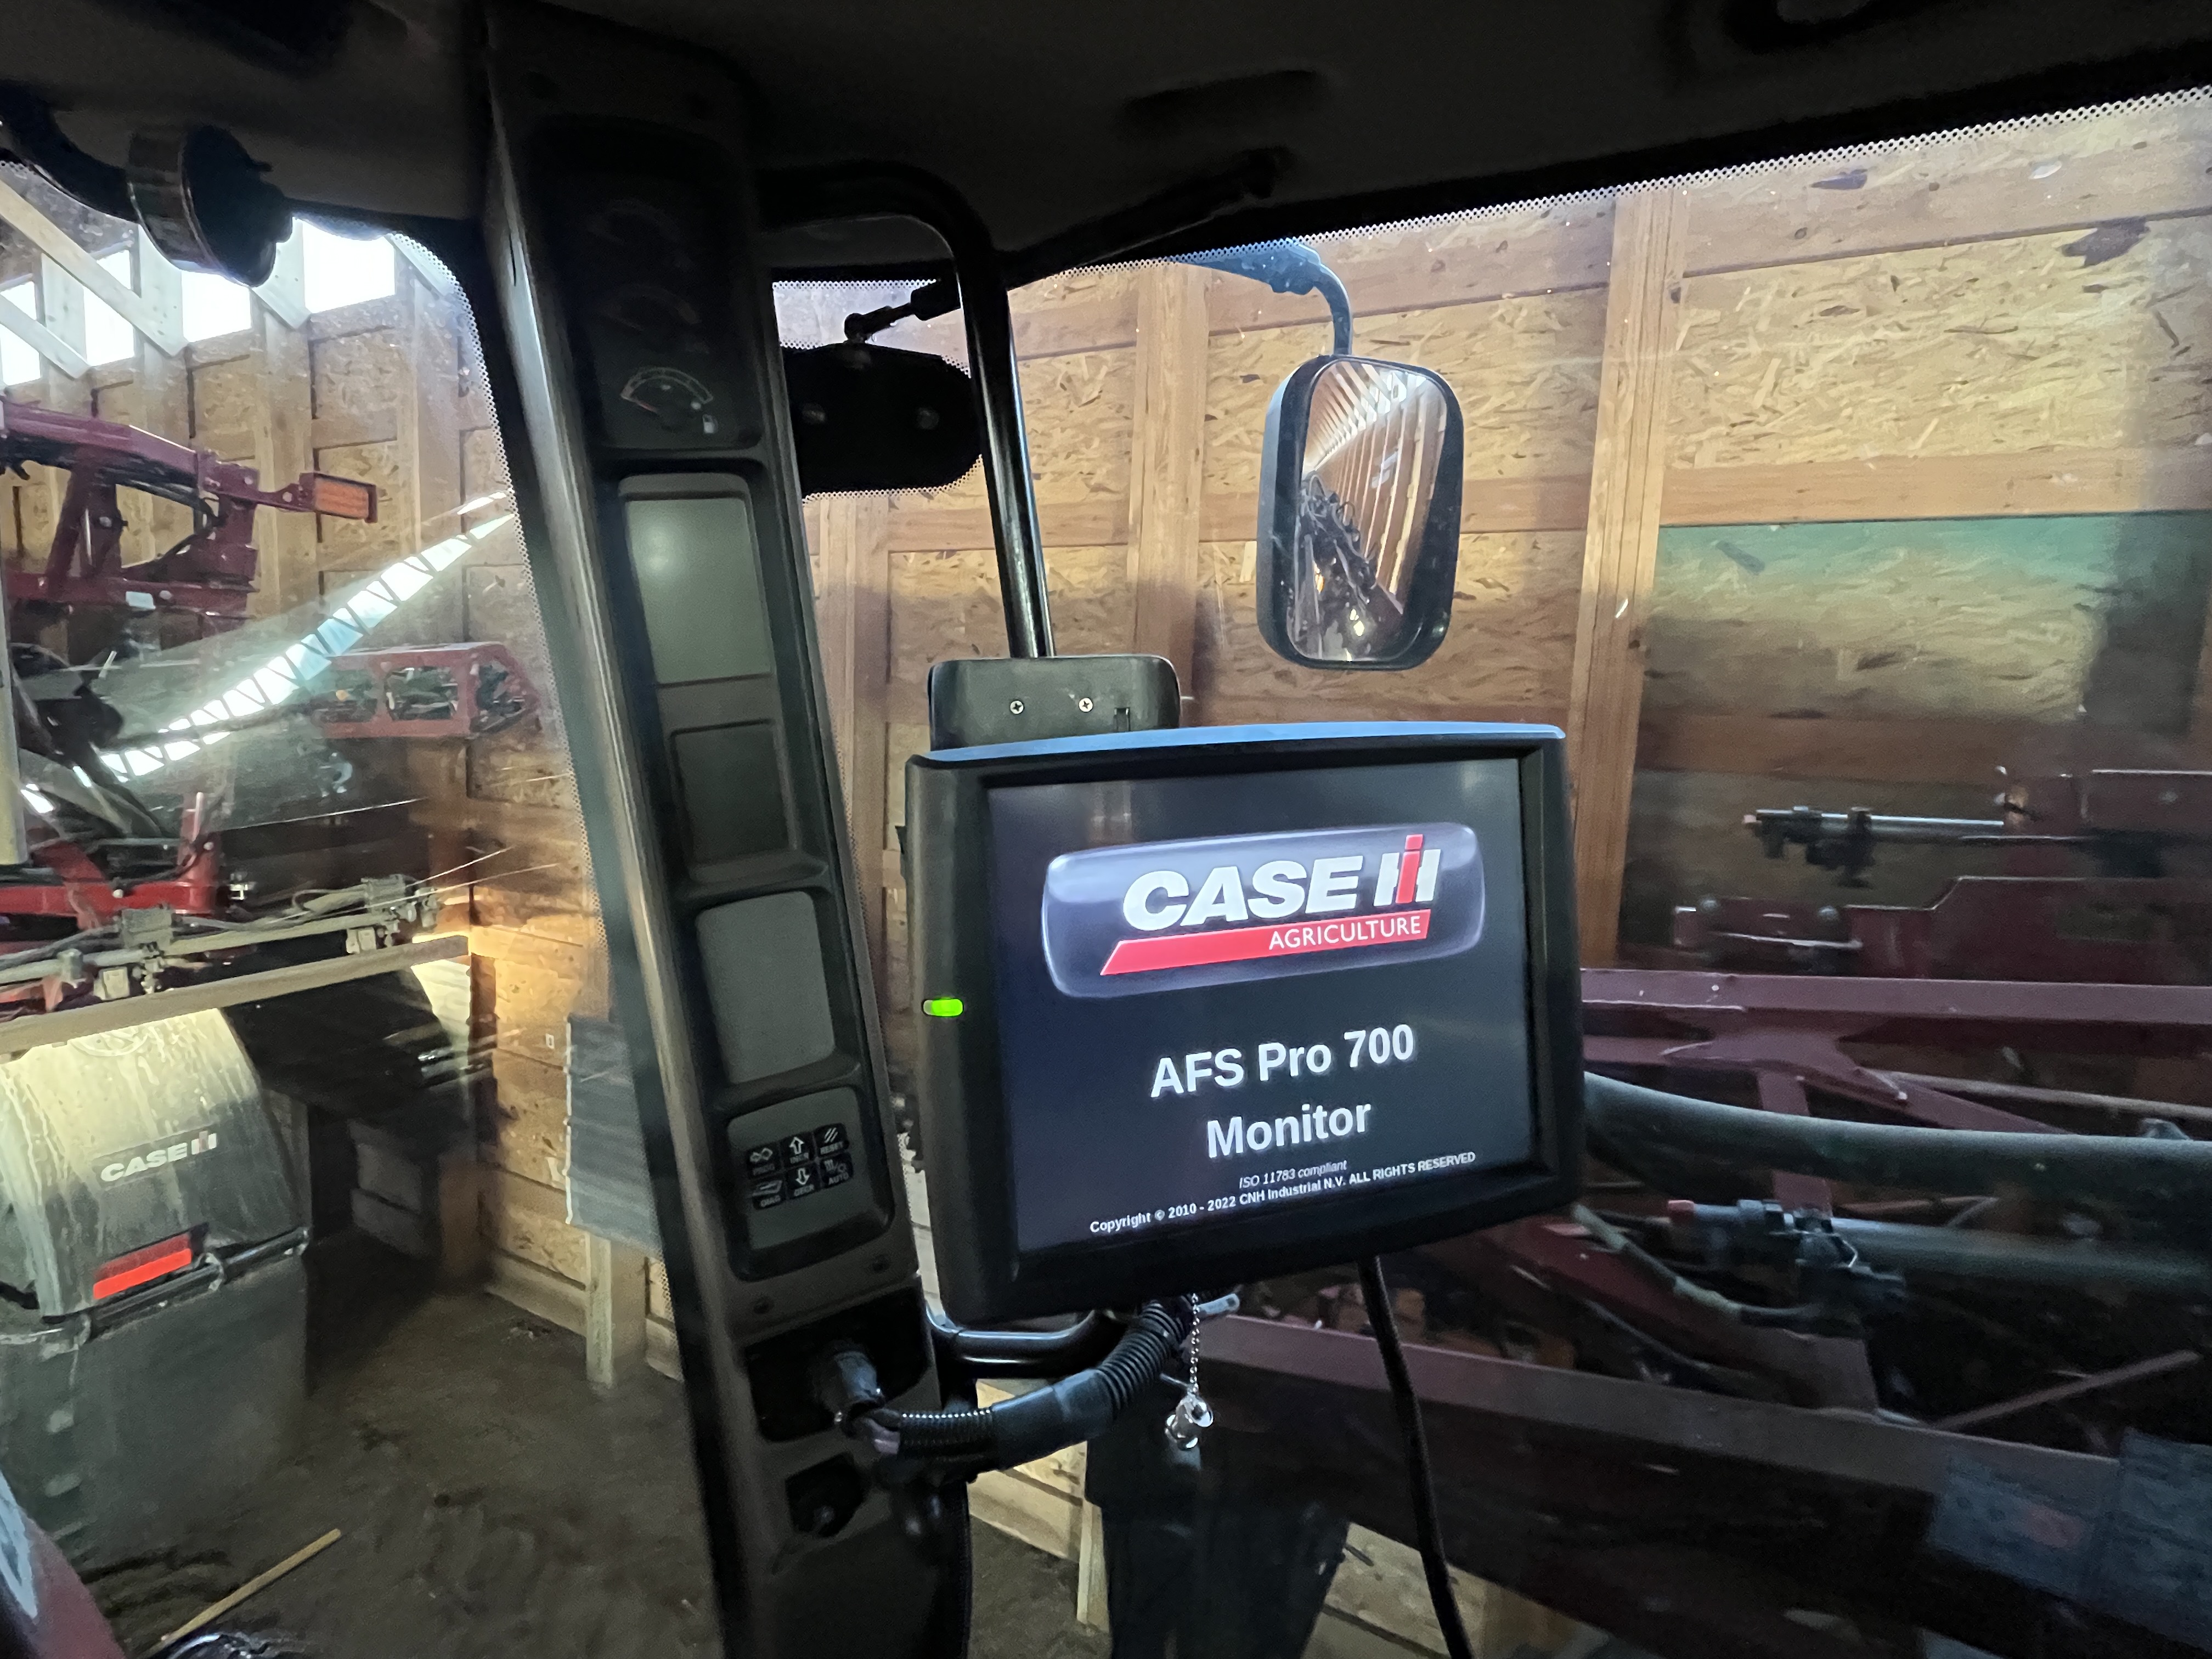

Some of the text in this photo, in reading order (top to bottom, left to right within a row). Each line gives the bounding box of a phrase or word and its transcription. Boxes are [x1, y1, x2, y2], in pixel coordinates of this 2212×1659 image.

[1123, 855, 1364, 931] CASE
[1268, 916, 1421, 950] AGRICULTURE
[1150, 1024, 1414, 1098] AFS Pro 700
[1207, 1103, 1372, 1159] Monitor
[100, 1142, 188, 1182] CASE
[828, 1171, 849, 1186] AUTO
[1239, 1160, 1347, 1189] ISO 11783 compliant
[1090, 1212, 1151, 1233] Copyright
[1168, 1203, 1197, 1218] 2010
[1207, 1195, 1236, 1211] 2022
[1239, 1190, 1265, 1205] CNH
[1267, 1180, 1321, 1200] Industrial
[1324, 1175, 1346, 1189] N.V.
[1348, 1171, 1371, 1184] ALL
[1373, 1163, 1416, 1181] RIGHTS
[1418, 1152, 1476, 1172] RESERVED
